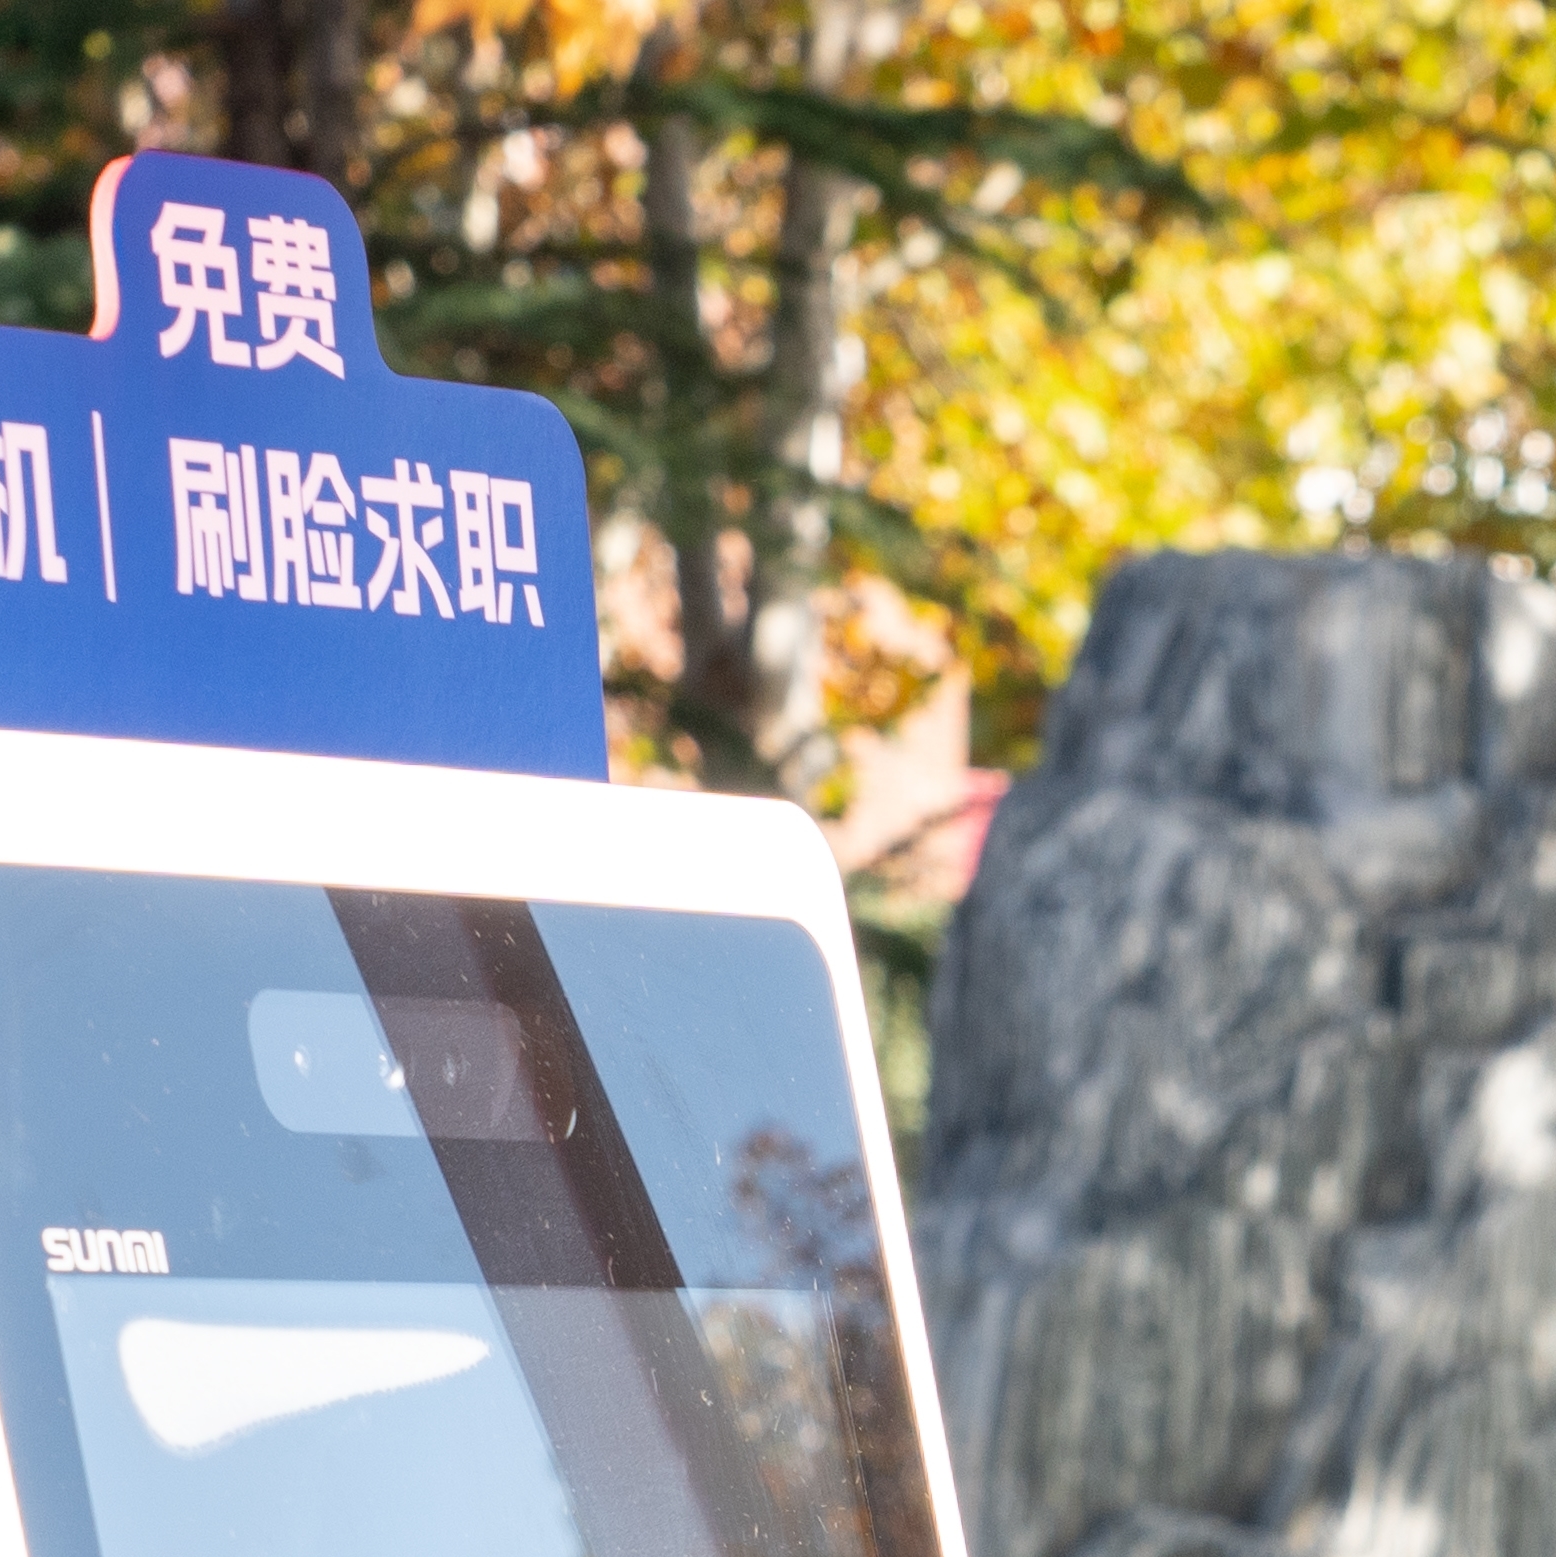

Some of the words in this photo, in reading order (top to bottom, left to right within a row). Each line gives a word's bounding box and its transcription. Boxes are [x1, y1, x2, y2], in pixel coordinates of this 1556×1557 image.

[148, 200, 347, 380] 免费
[168, 436, 545, 628] 刷脸求职
